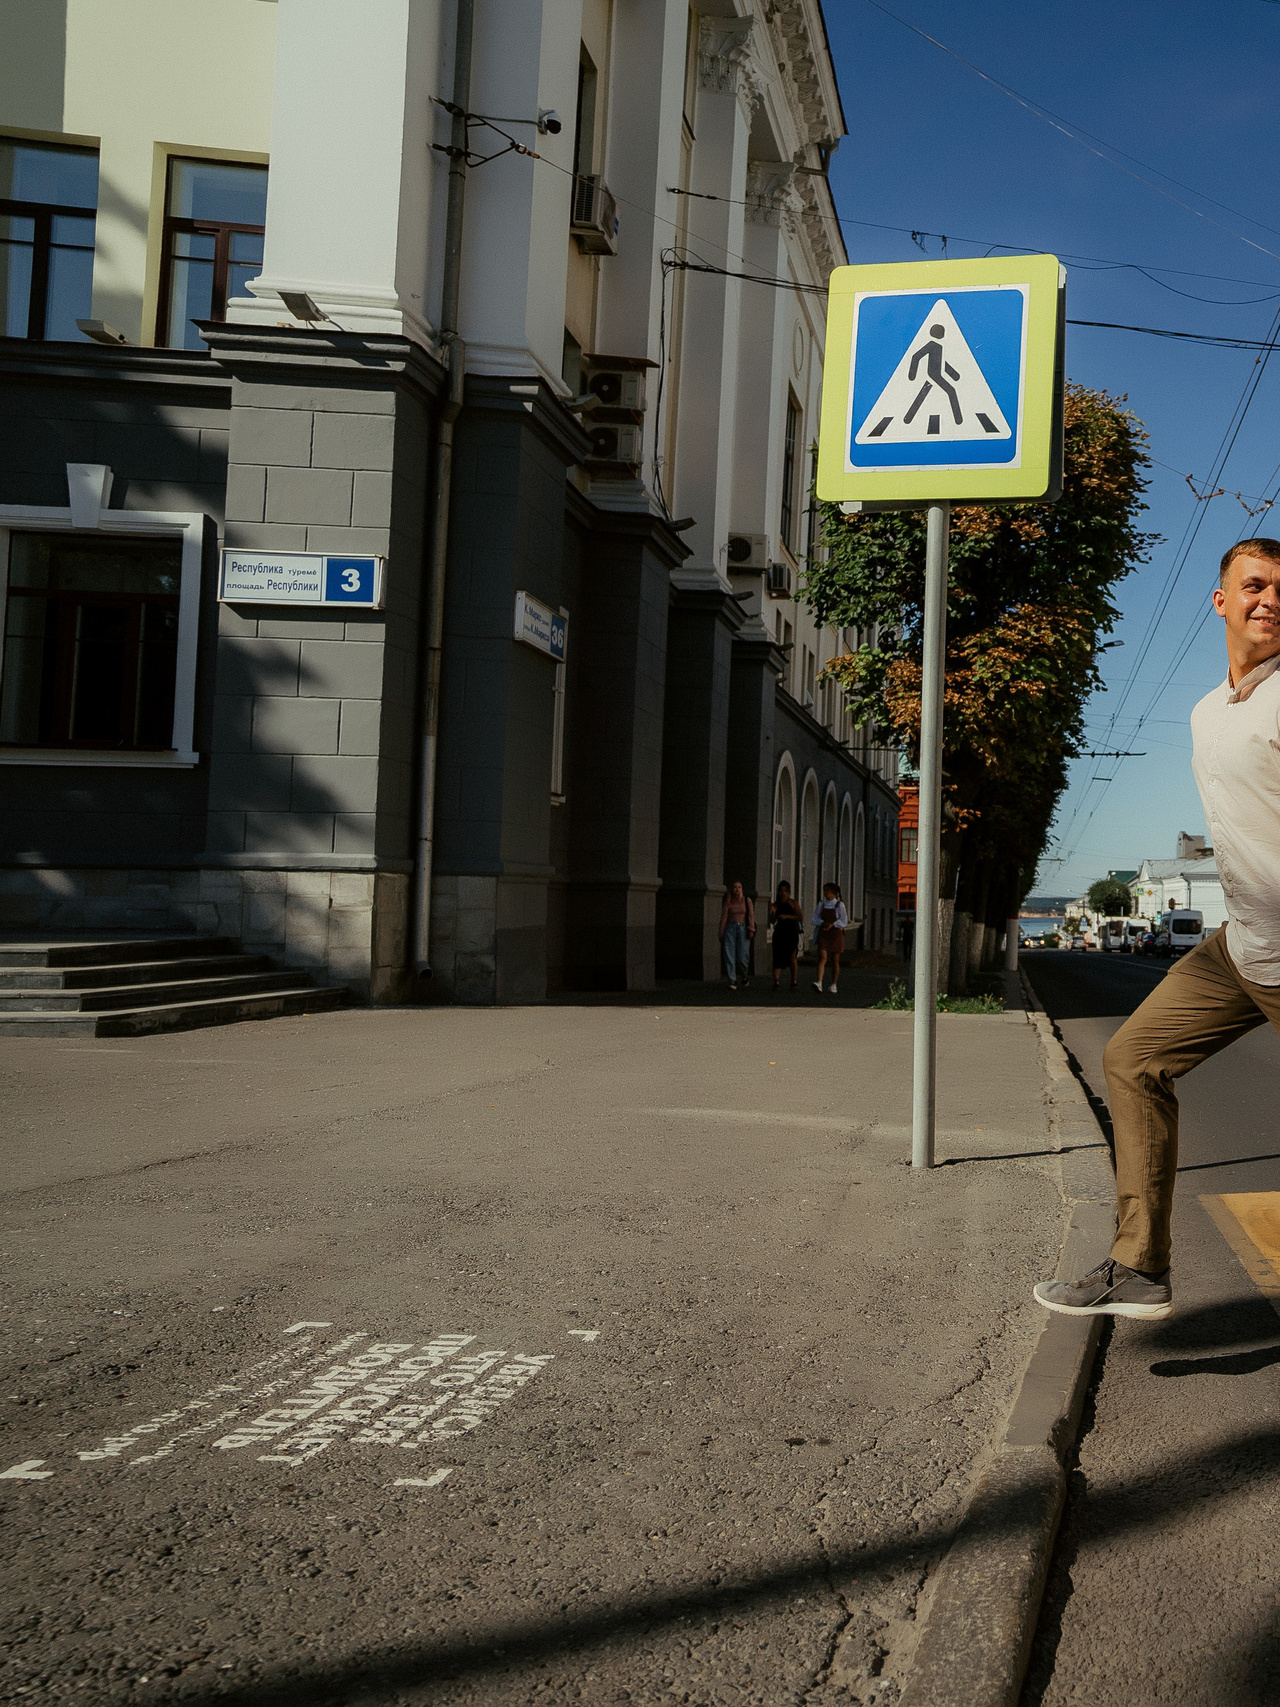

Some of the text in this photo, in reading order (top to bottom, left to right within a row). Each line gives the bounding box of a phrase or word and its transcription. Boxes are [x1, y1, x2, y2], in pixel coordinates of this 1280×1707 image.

[231, 561, 284, 575] Республика
[340, 568, 361, 592] 3
[267, 579, 319, 593] Республики
[551, 624, 564, 649] 36
[212, 1342, 415, 1450] ВОДИТЕЛЬ
[256, 1333, 478, 1467] ПРОПУСКАЕТ
[349, 1350, 509, 1445] ЧТО ТЕБЯ
